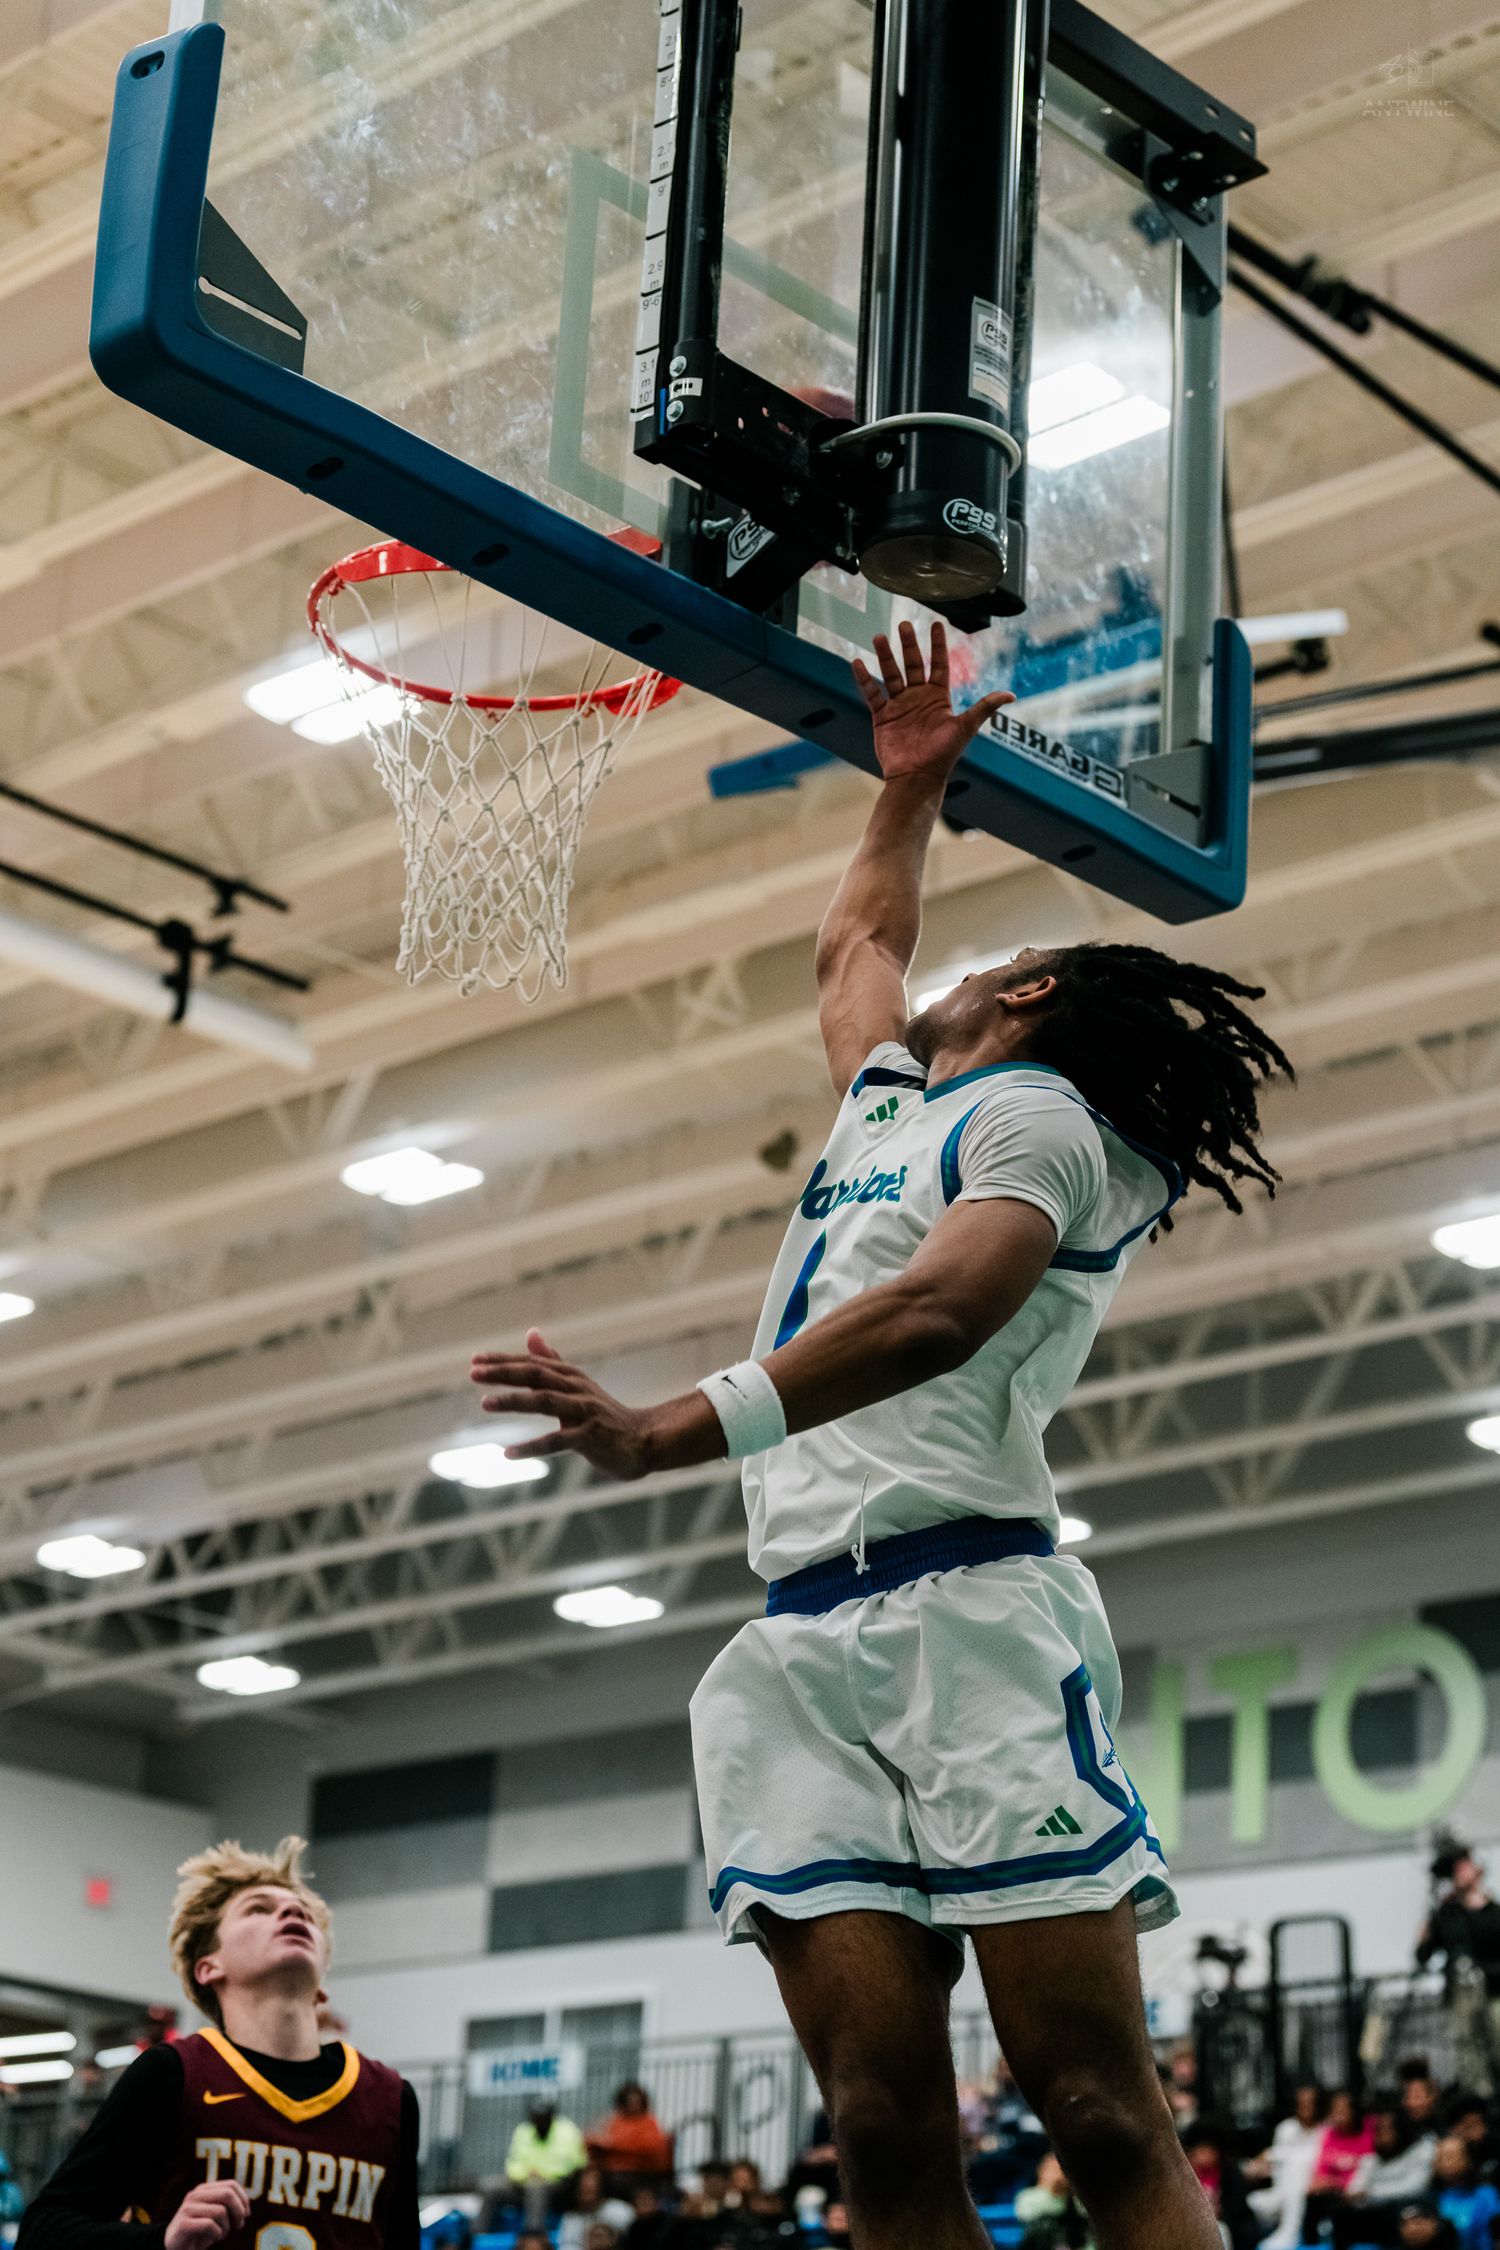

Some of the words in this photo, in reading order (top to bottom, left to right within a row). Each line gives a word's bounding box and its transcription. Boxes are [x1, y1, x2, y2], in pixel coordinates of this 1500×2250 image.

[648, 260, 664, 275] 2.9
[650, 279, 659, 289] m
[640, 358, 655, 373] 3.1
[641, 378, 651, 388] m
[951, 502, 996, 531] PSS
[195, 2137, 386, 2223] TURPIN
